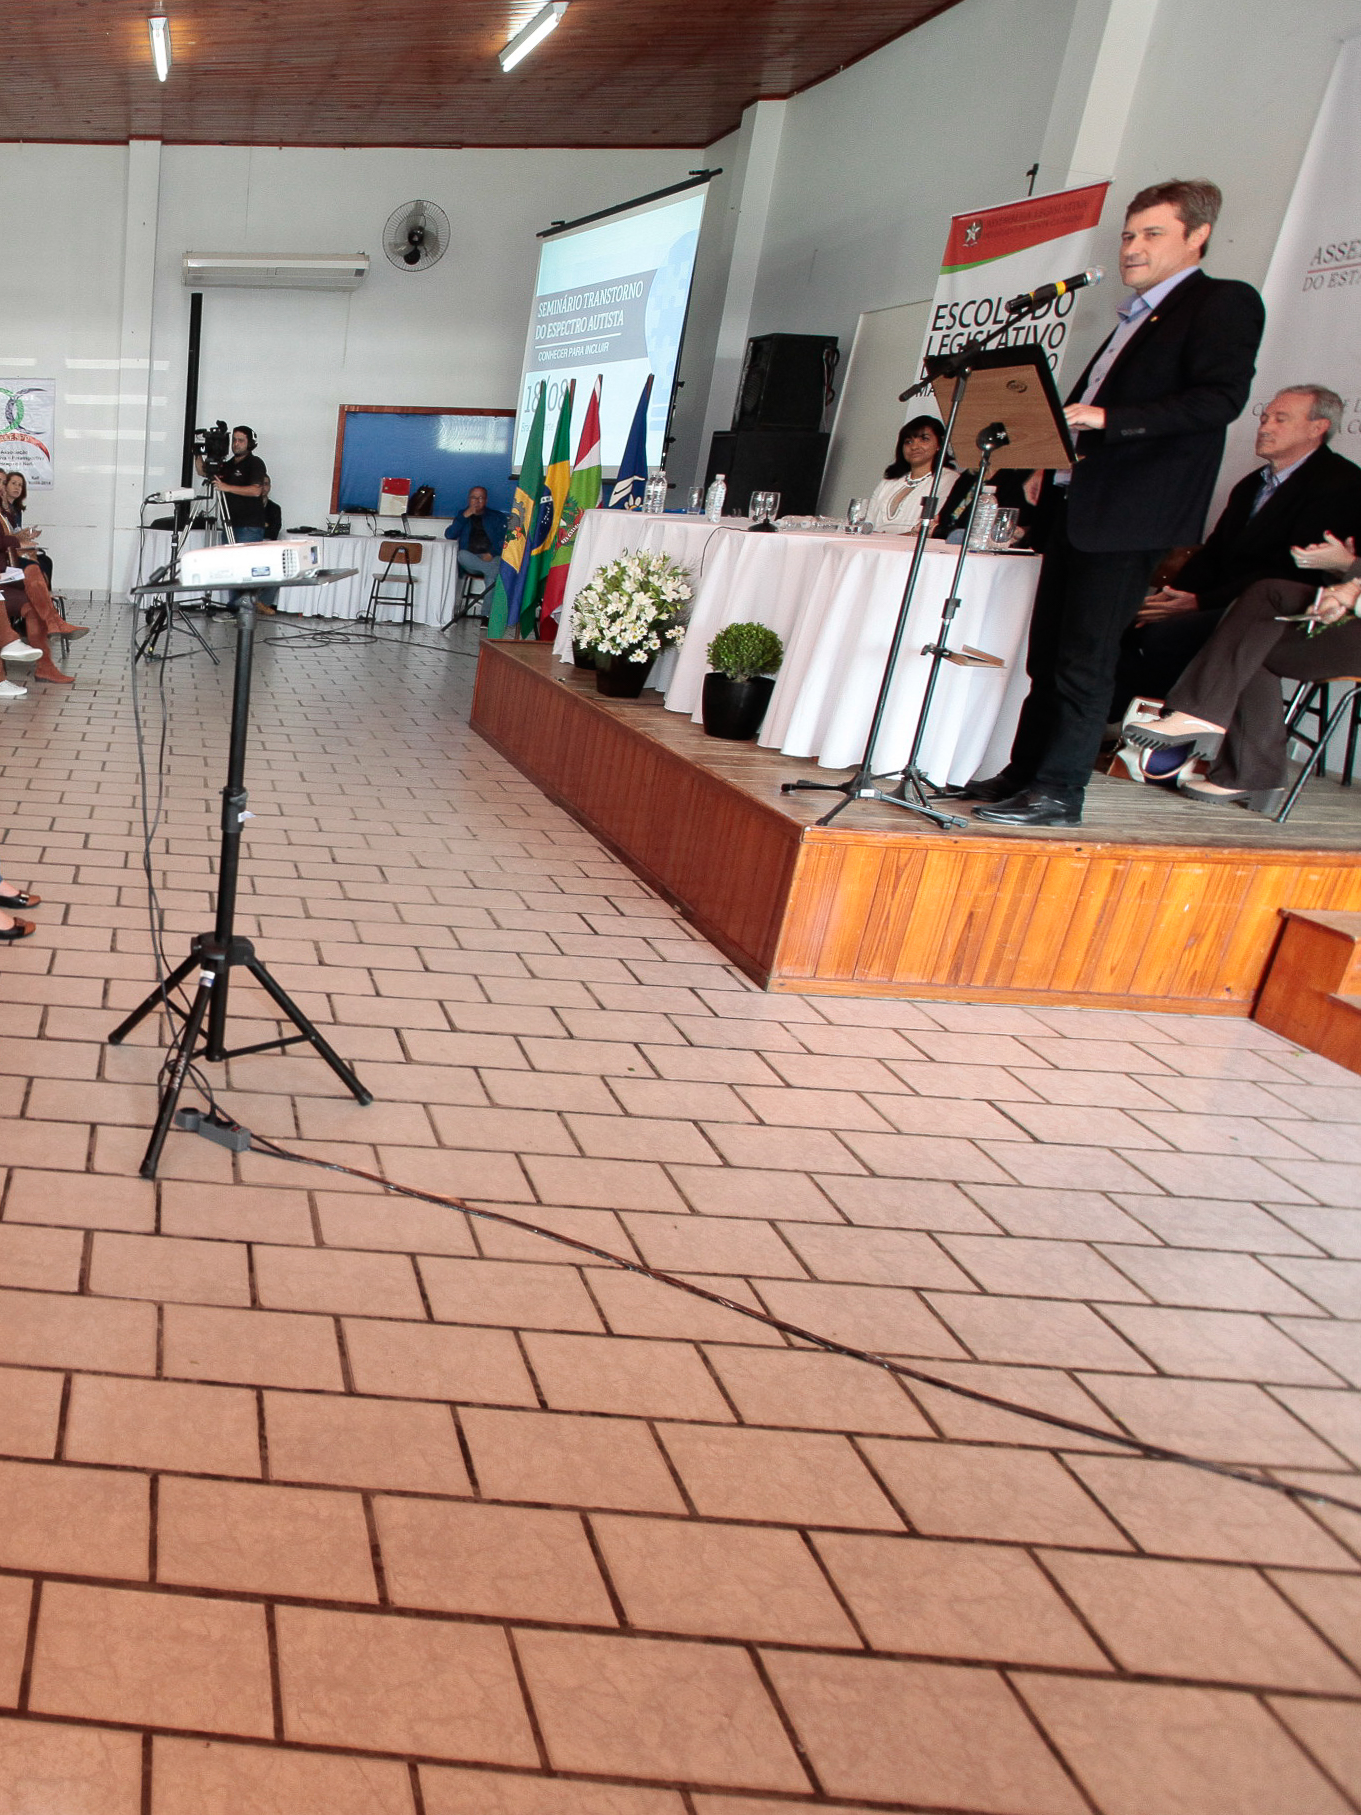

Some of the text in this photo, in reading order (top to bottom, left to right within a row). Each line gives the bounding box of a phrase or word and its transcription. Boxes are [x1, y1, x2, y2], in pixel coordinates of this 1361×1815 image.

[1302, 269, 1361, 292] DO EST
[538, 281, 644, 318] SEMINÁRIO TRANSTORNO
[535, 310, 624, 340] DO ESPECTRO AUTISTA
[539, 342, 610, 361] CONHECER PARA INCLUIR
